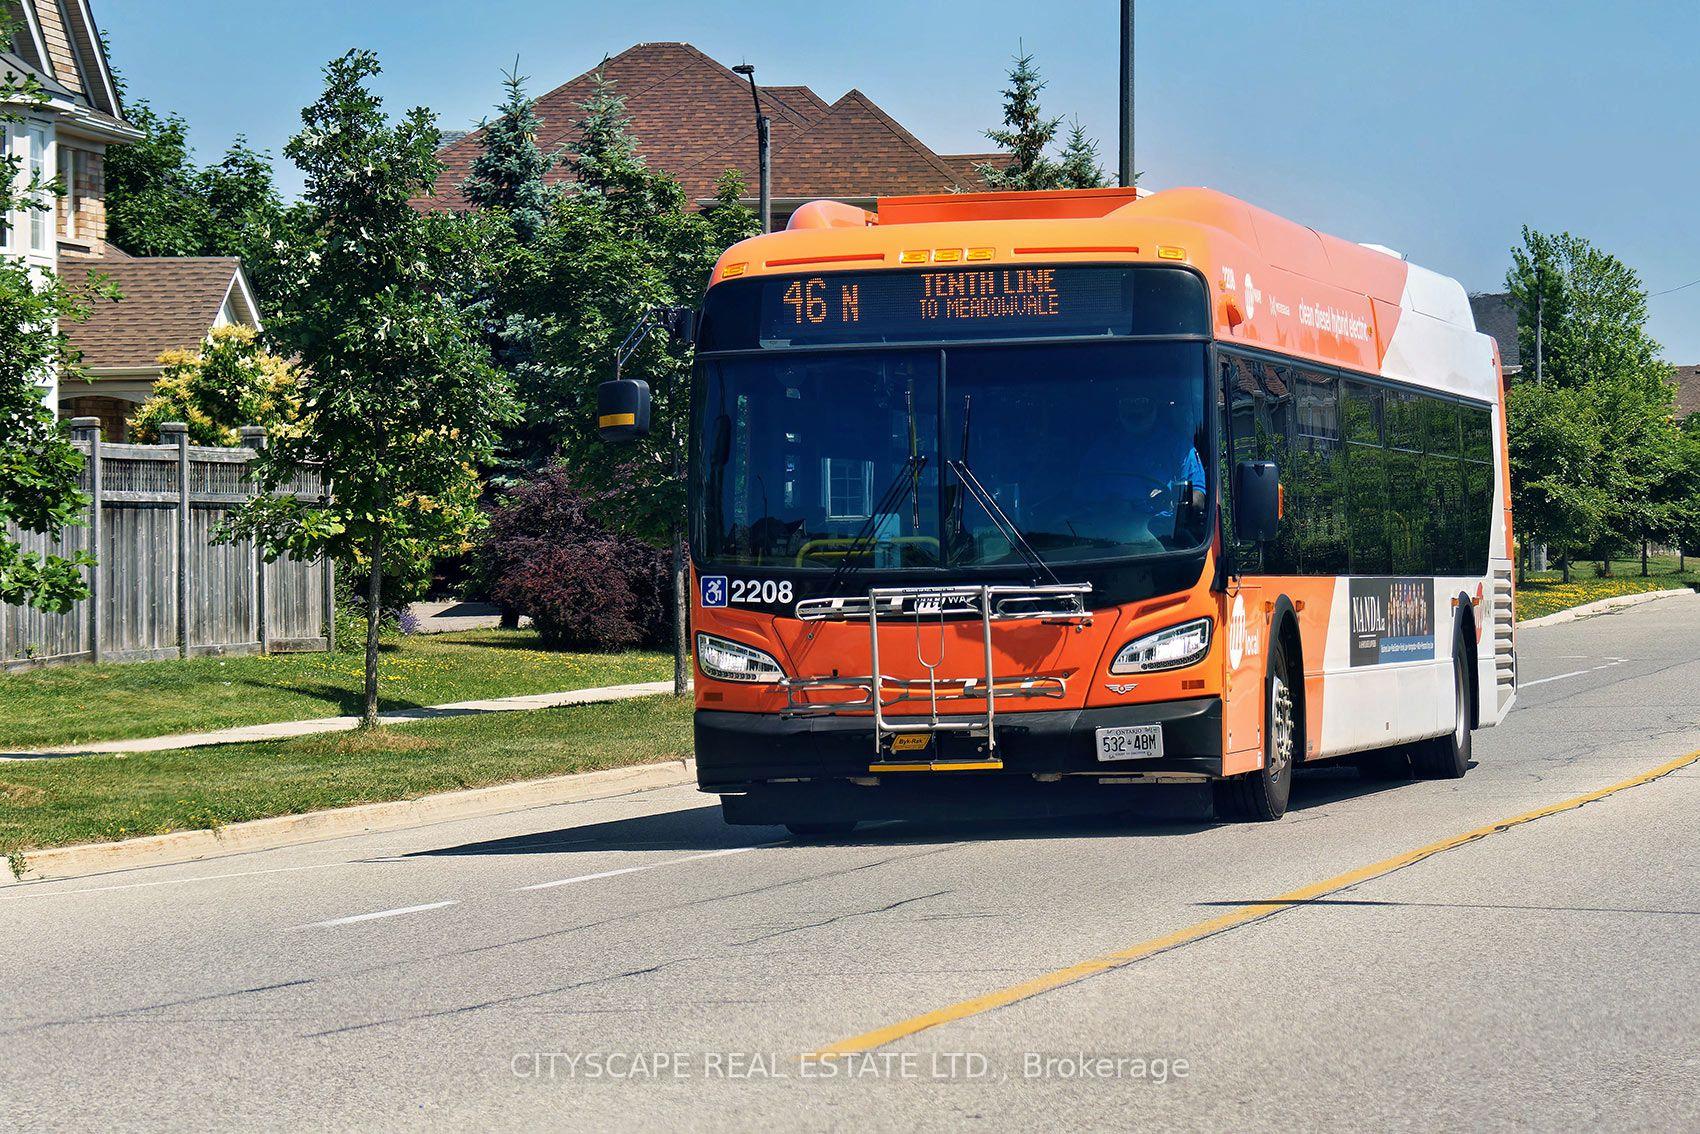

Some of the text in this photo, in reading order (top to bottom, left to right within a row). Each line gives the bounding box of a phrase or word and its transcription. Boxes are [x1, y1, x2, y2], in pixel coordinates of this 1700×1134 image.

[920, 268, 1056, 298] TENTH LINE
[783, 277, 859, 324] 46 N
[920, 294, 1060, 319] TO MEADOWVALE
[731, 580, 793, 604] 2208
[1353, 596, 1381, 633] NANDA
[1102, 734, 1157, 753] 532 4BM
